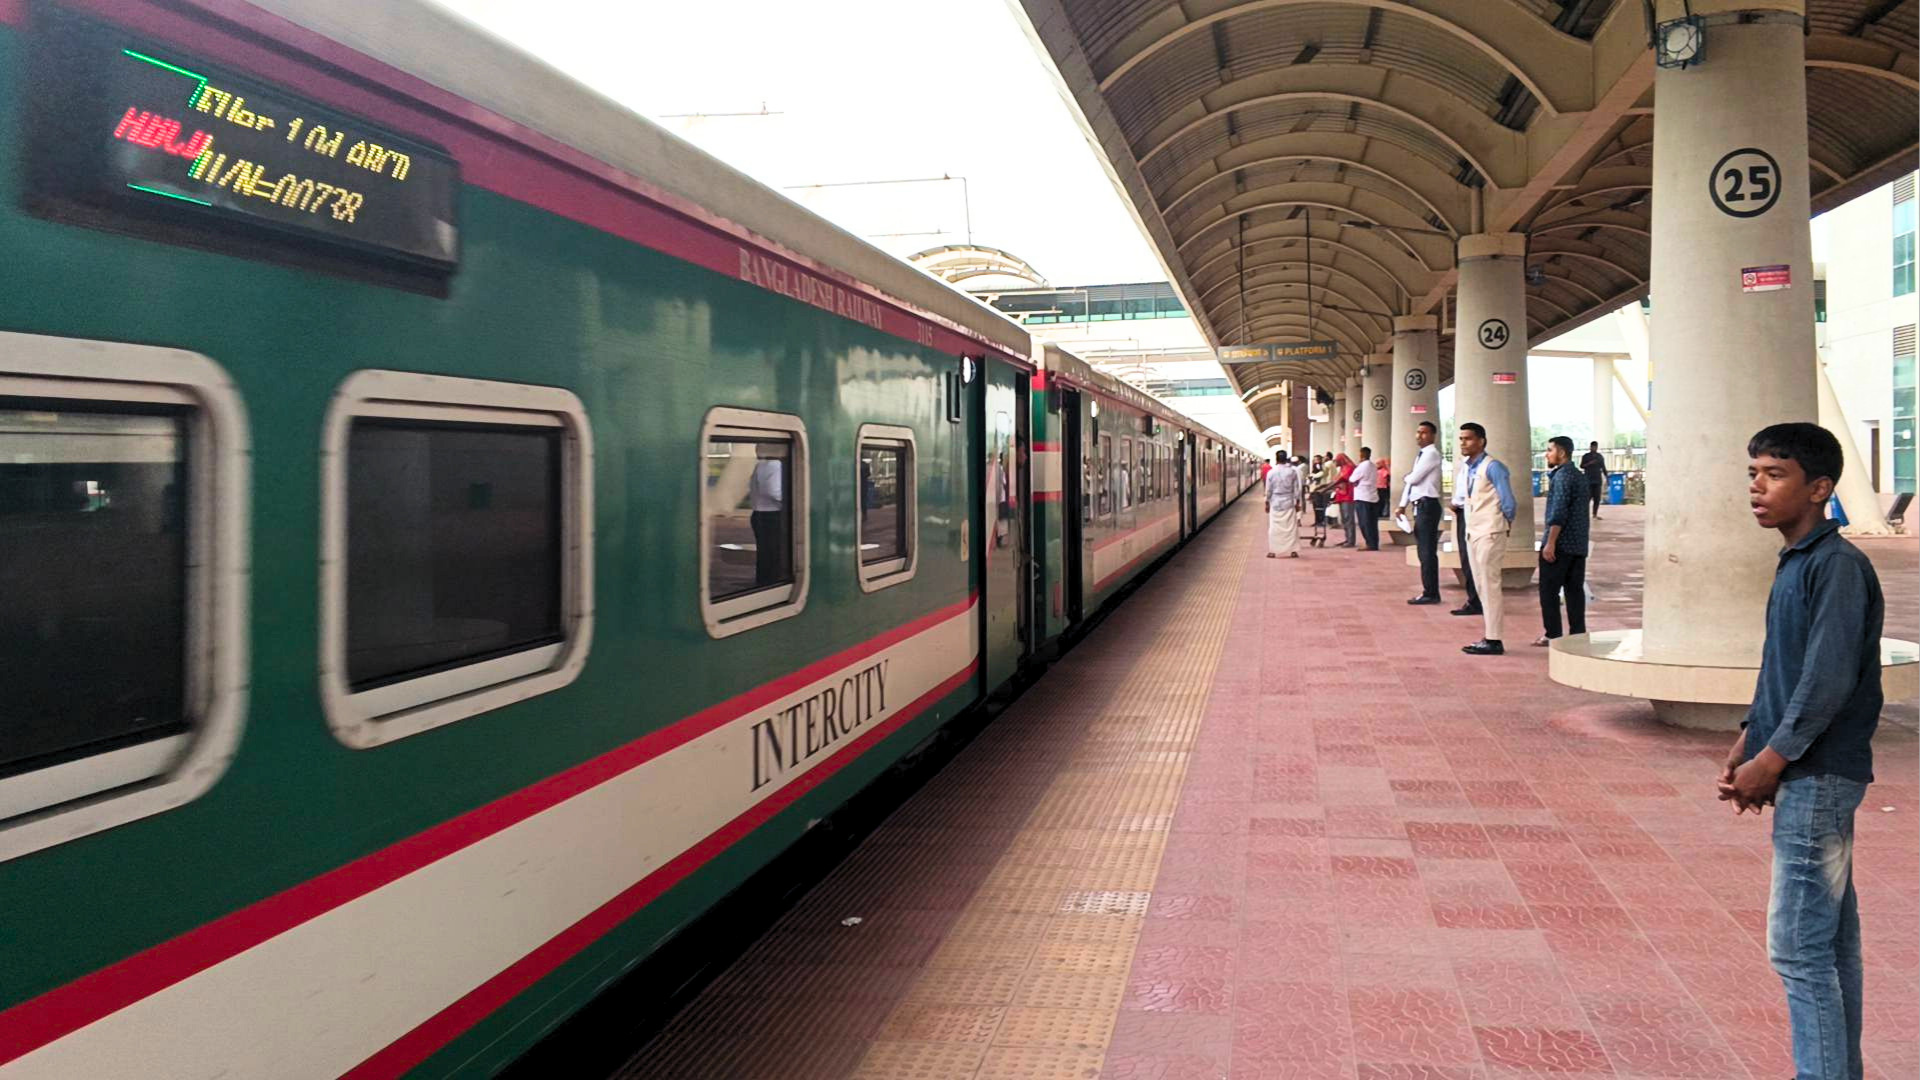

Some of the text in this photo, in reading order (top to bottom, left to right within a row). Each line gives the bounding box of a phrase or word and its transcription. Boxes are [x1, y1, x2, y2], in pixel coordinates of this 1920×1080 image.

[1724, 166, 1770, 202] 25
[739, 248, 883, 330] BANGLADESH RAILWAY
[1483, 326, 1505, 343] 24
[1285, 345, 1327, 357] PLATFORM
[1408, 374, 1423, 386] 23
[1374, 399, 1385, 408] 22
[750, 659, 889, 793] INTERCITY
